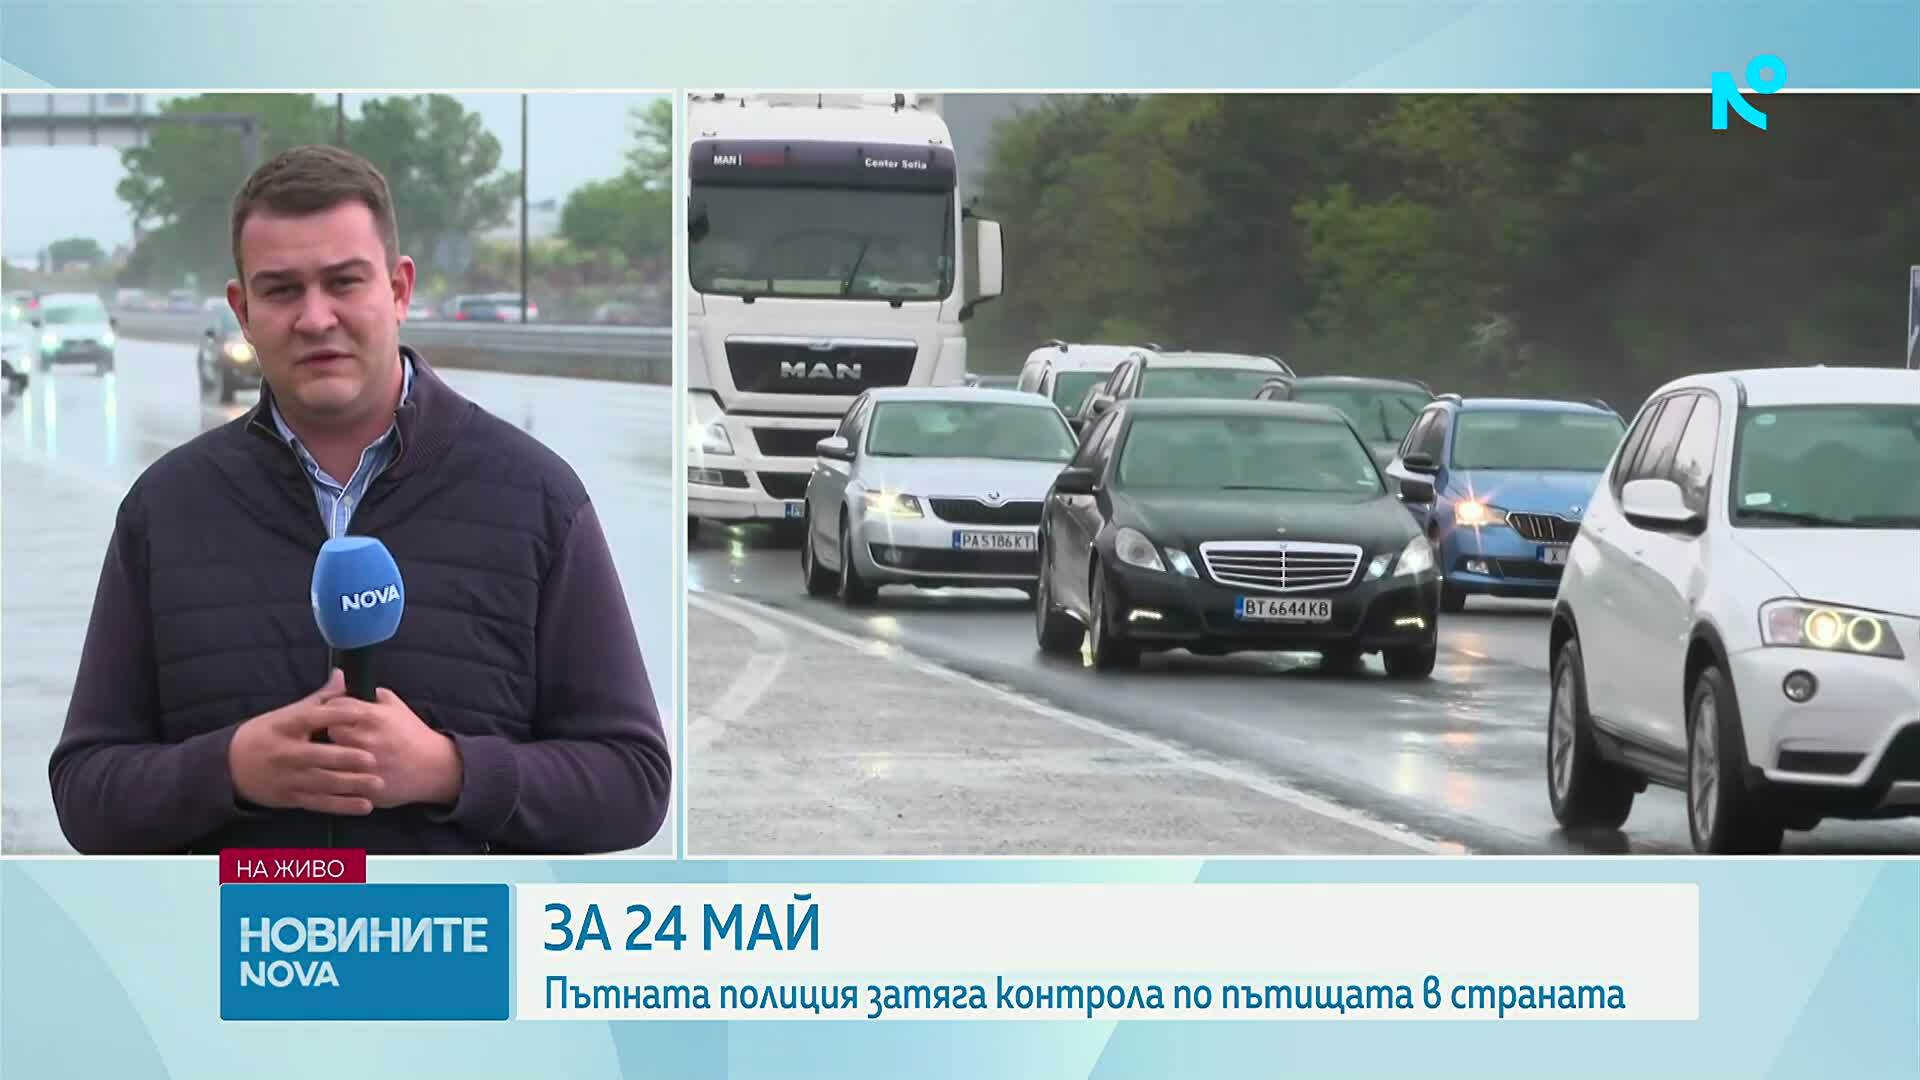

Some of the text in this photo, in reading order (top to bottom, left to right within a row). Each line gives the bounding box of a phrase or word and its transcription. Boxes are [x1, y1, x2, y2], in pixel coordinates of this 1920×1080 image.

[713, 155, 737, 165] MAN
[864, 157, 927, 170] Center Sofia
[780, 361, 862, 379] MAN
[342, 583, 401, 612] NOVA
